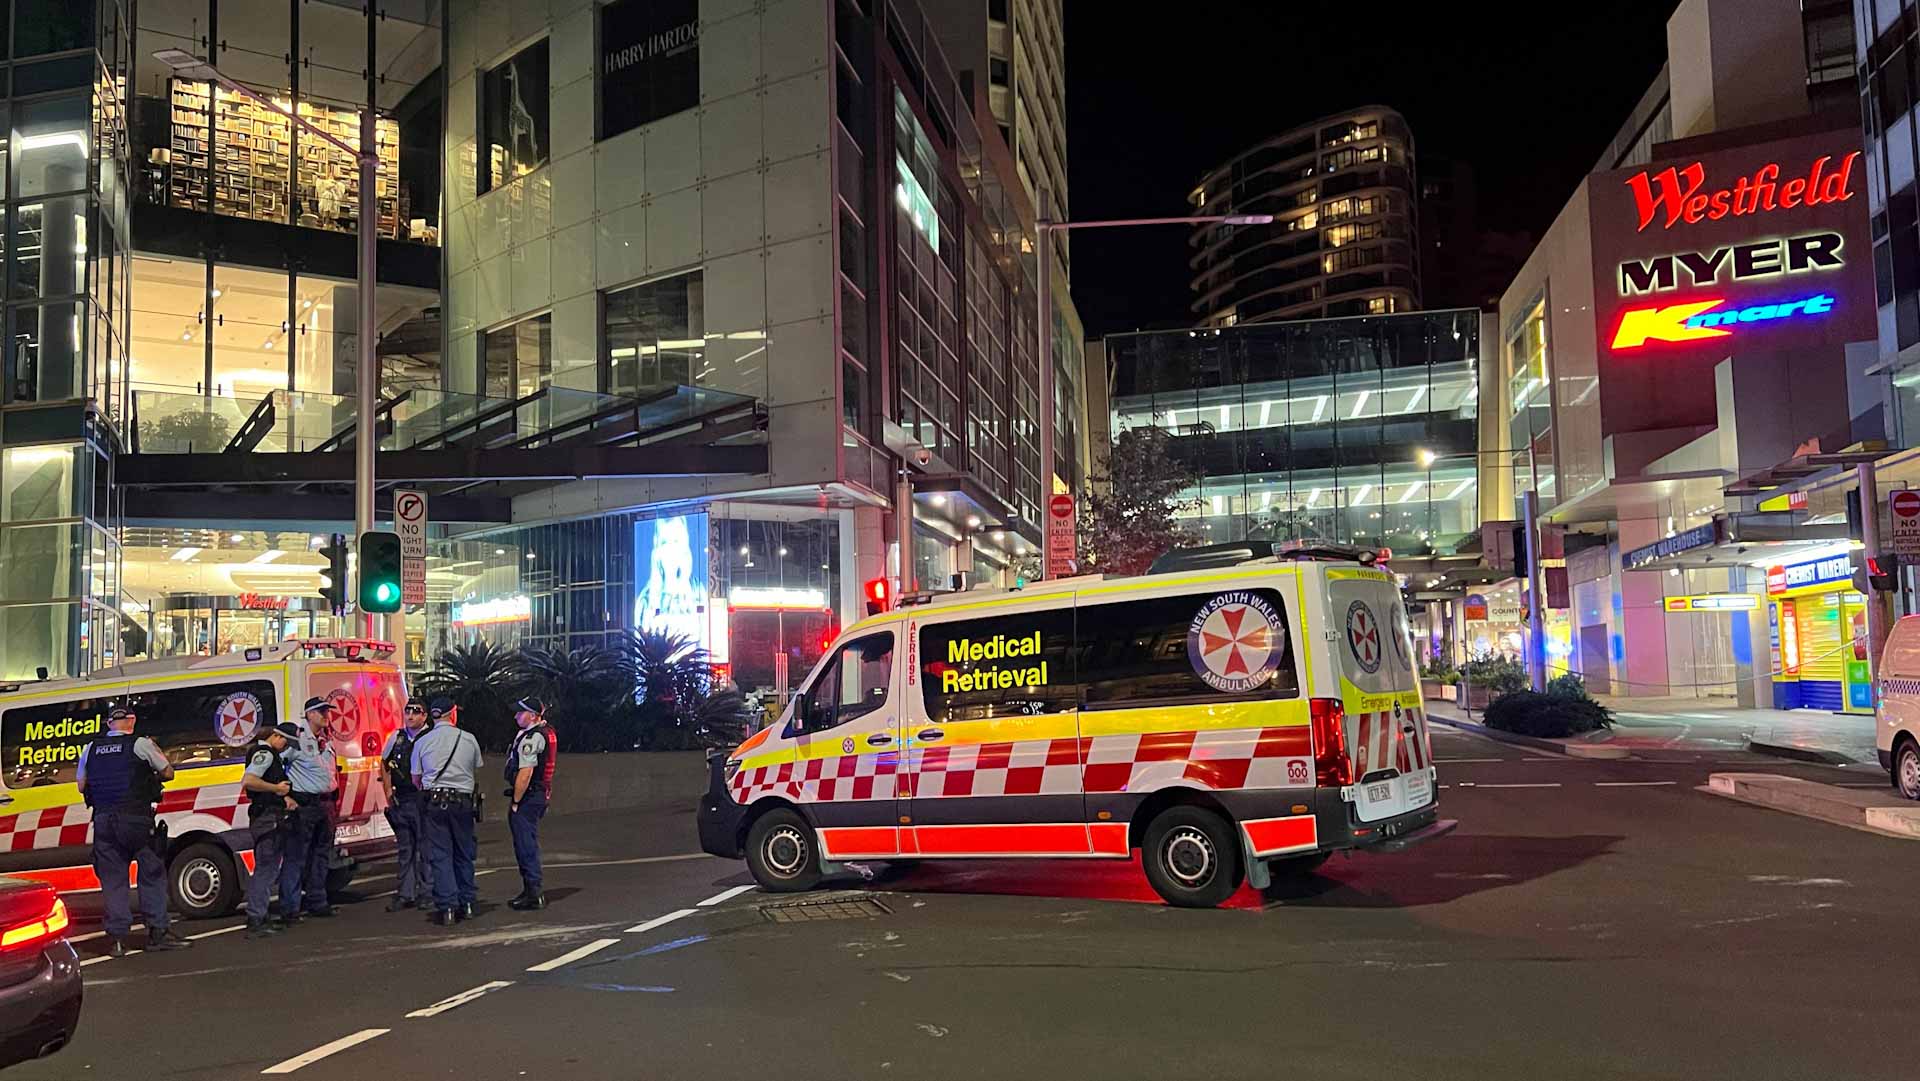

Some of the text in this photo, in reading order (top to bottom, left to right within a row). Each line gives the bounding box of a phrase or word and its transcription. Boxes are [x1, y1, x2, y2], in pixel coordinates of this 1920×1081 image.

[605, 43, 646, 75] HARRY
[1624, 151, 1861, 233] Westfield
[1619, 232, 1845, 297] MYER
[1611, 294, 1835, 349] Kmart
[402, 524, 419, 535] NO
[402, 537, 422, 545] IGHT
[1657, 530, 1701, 557] WAREHOUSE
[1785, 563, 1816, 585] CHEMIST
[1817, 556, 1851, 579] WAREHO
[1190, 592, 1281, 634] NEW SOUTH WALES
[948, 631, 1041, 663] Medical
[942, 661, 1048, 693] Retrieval
[1202, 666, 1271, 690] AMBULANCE
[216, 691, 263, 715] NEW SOUTH WALES
[25, 713, 101, 741] Medical
[19, 742, 88, 766] Retriev
[95, 743, 122, 755] POLICE
[1288, 767, 1308, 778] 000
